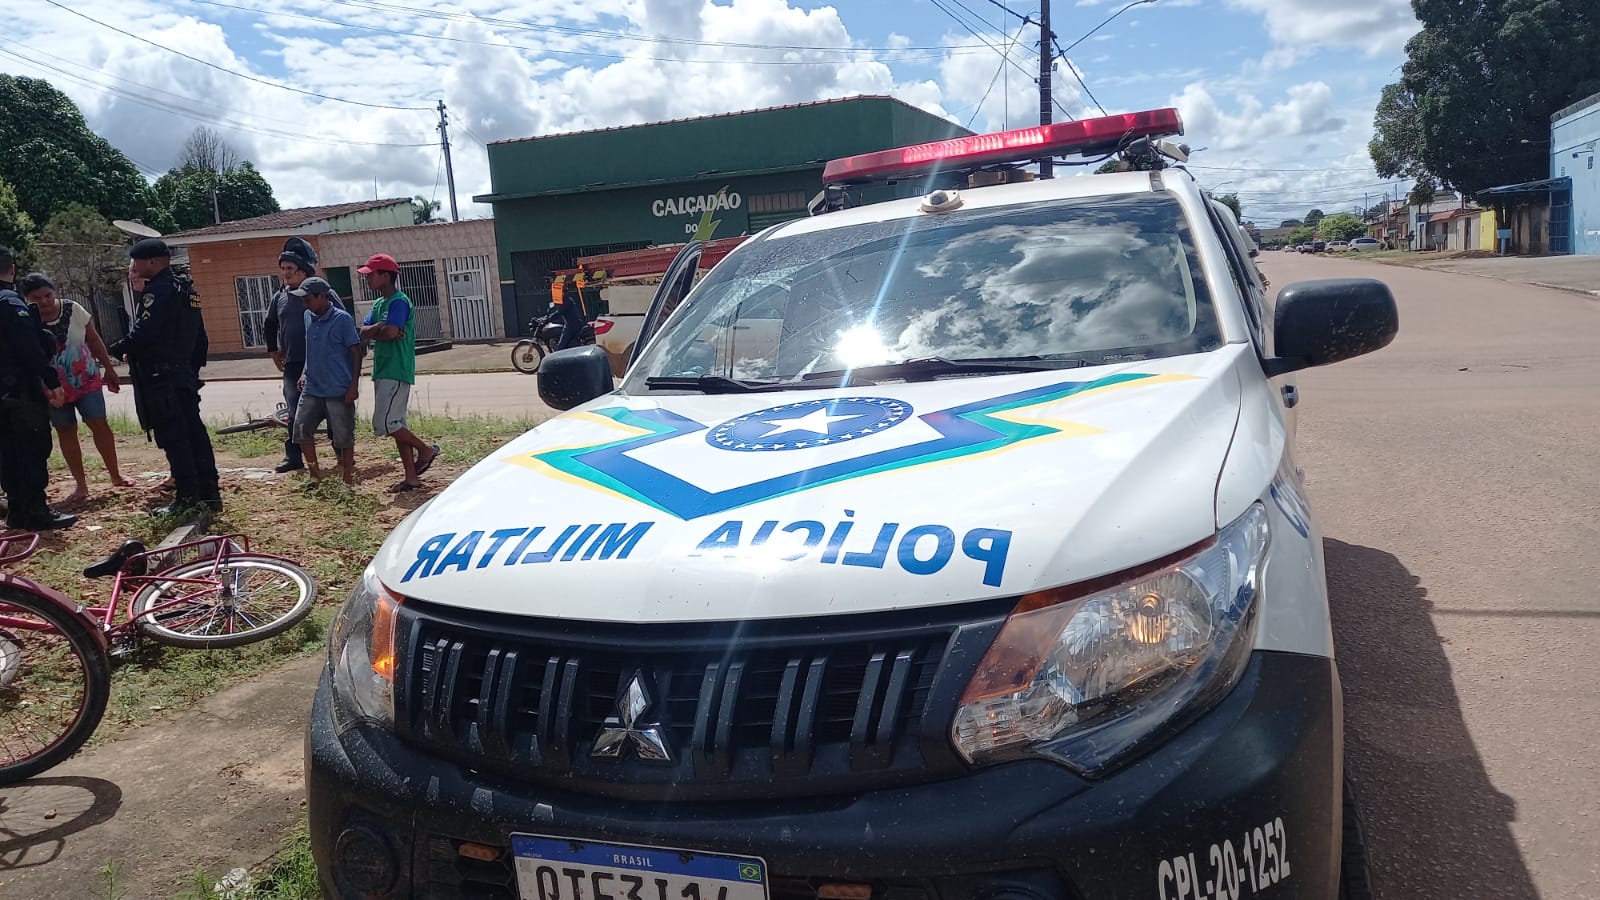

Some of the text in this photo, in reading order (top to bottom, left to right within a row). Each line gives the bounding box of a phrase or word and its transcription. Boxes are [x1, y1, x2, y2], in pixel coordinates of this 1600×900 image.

[652, 190, 742, 217] CALÇADÃO
[685, 223, 698, 234] DO
[613, 854, 653, 868] BRASIL
[1158, 816, 1291, 900] CPL-20-1252
